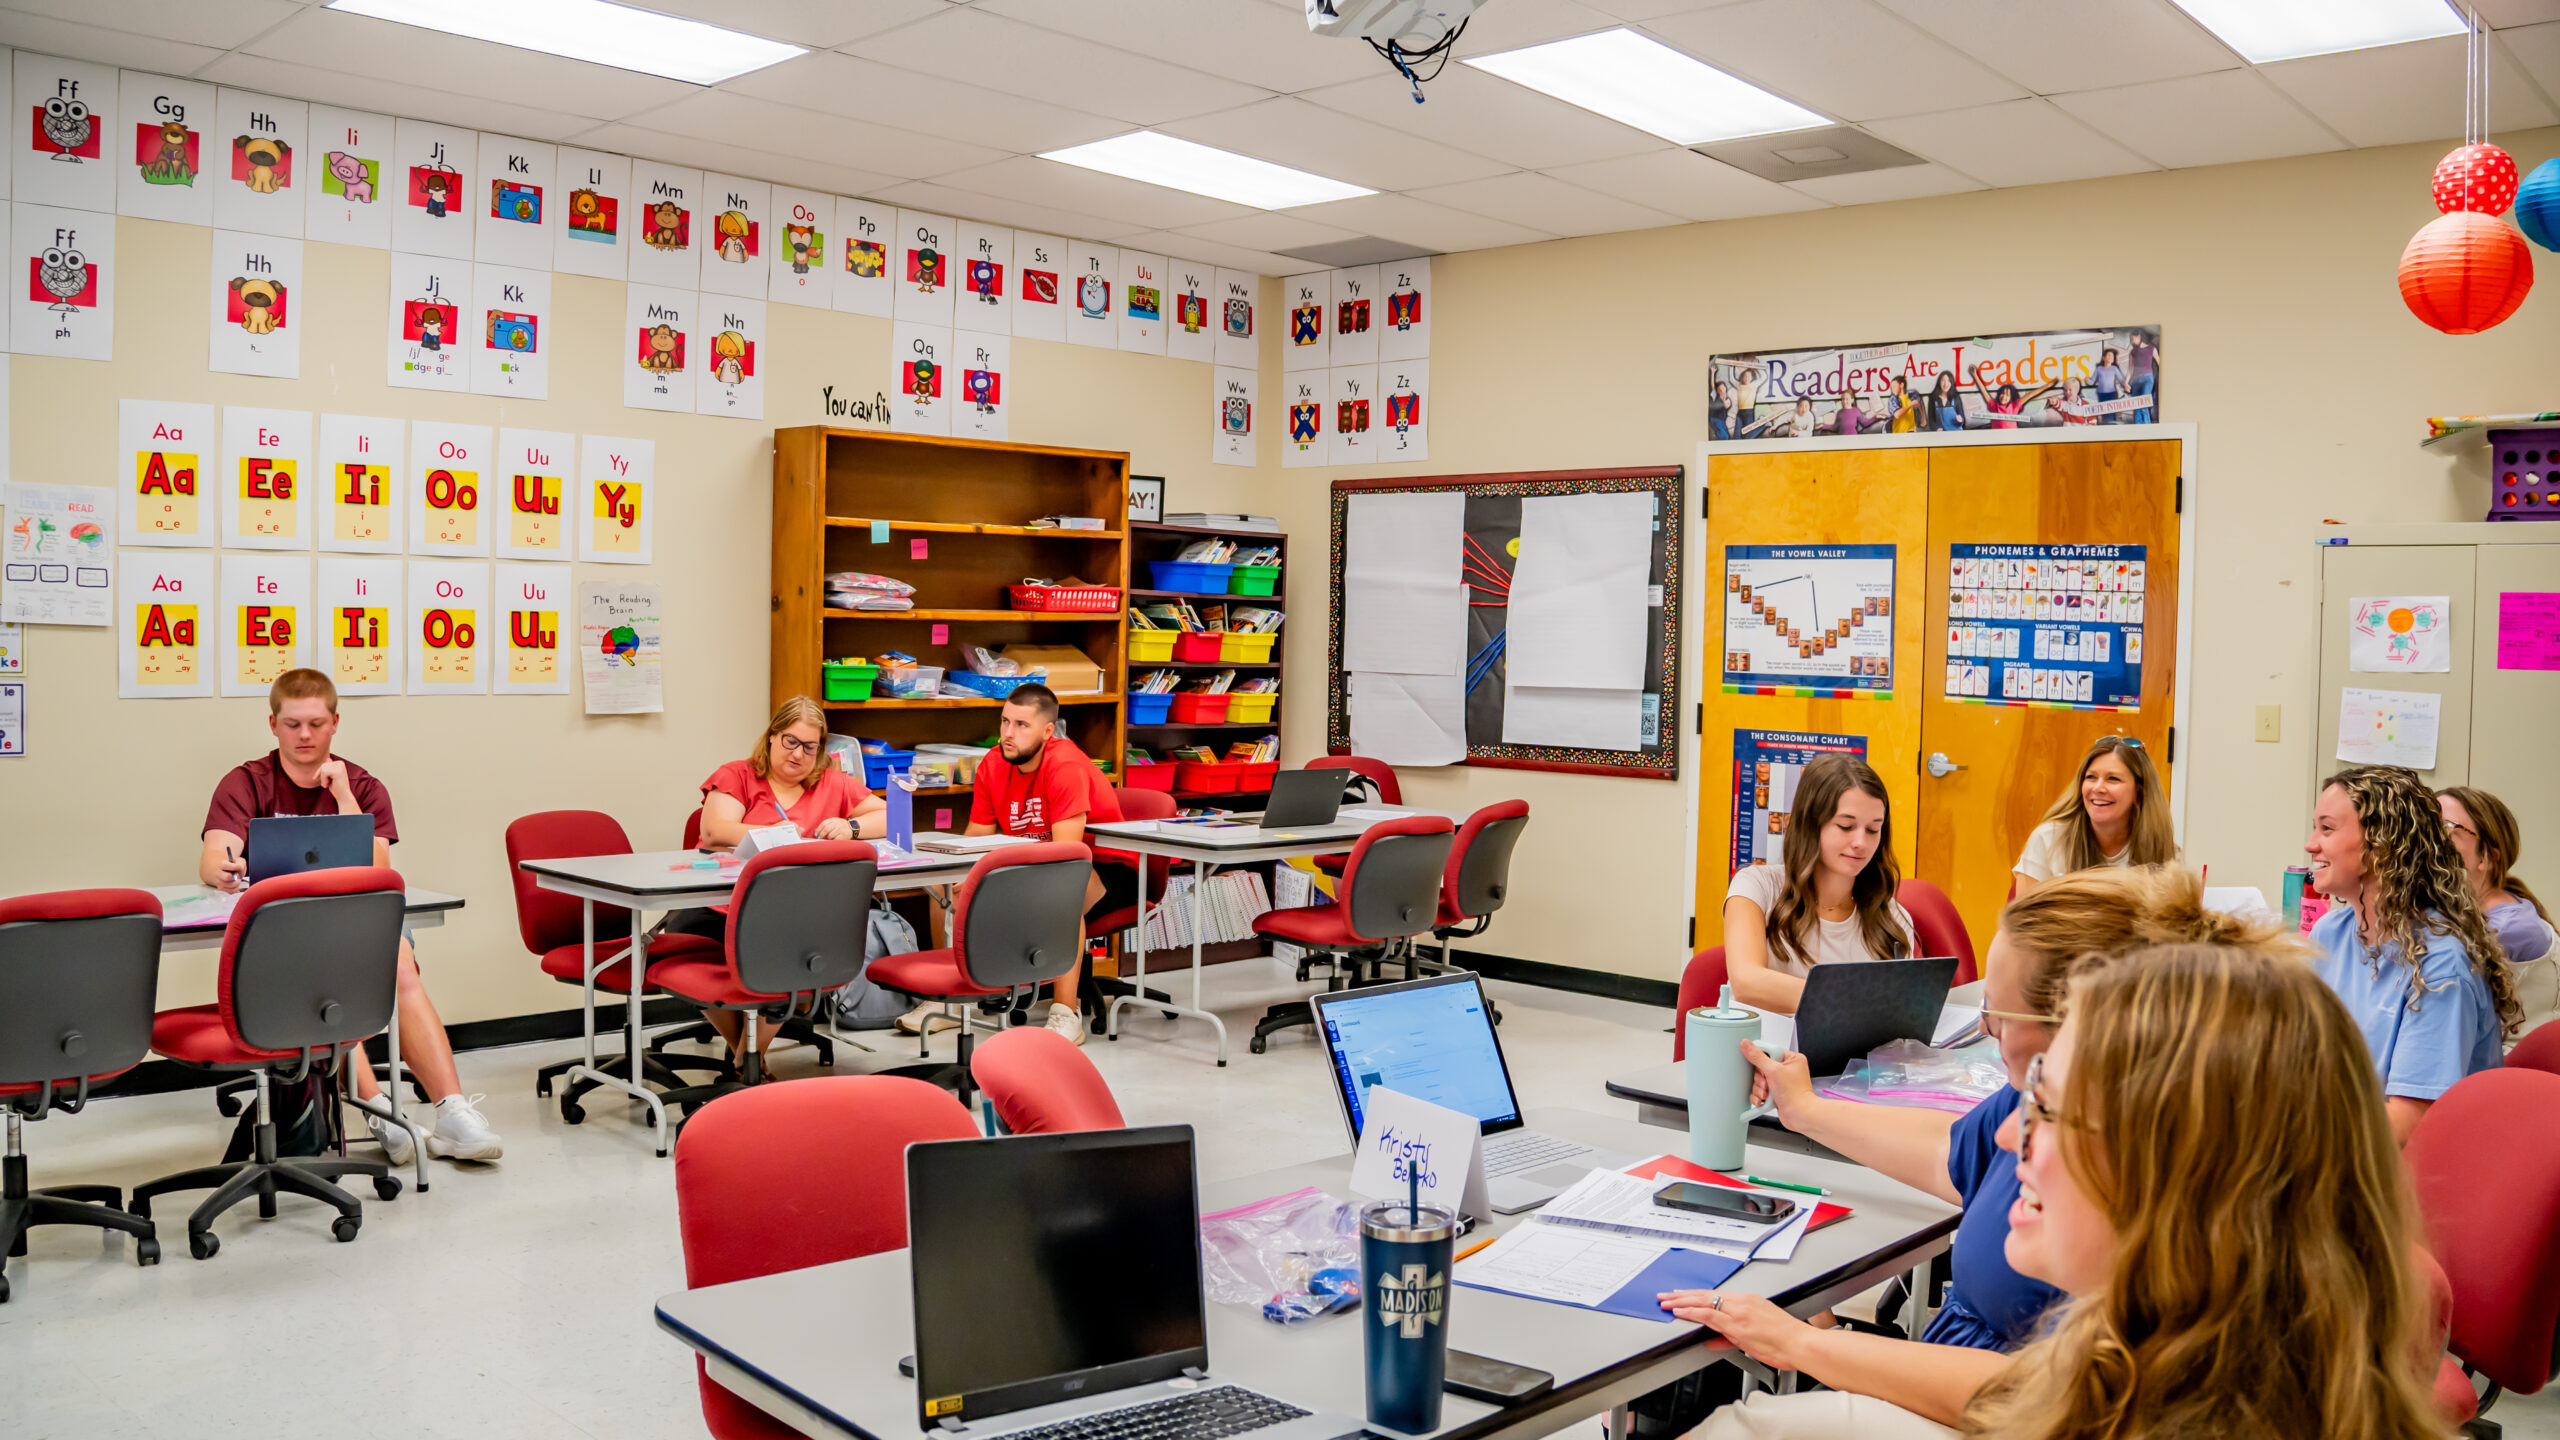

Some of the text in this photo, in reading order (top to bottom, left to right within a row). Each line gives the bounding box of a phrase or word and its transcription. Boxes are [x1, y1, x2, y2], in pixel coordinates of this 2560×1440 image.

[59, 79, 79, 98] Ff
[154, 96, 184, 122] Gg
[251, 112, 276, 132] Hh
[431, 142, 444, 164] Jj
[509, 155, 528, 173] Kk
[653, 181, 682, 199] Mm
[728, 193, 747, 210] Nn
[793, 205, 814, 221] Oo
[859, 216, 875, 235] Pp
[54, 229, 75, 249] Ff
[917, 228, 937, 249] Qq
[980, 238, 992, 253] Rr
[247, 254, 271, 273] Hh
[1036, 248, 1047, 262] Ss
[1089, 257, 1099, 271] Tt
[1138, 265, 1151, 280] Uu
[426, 275, 440, 298] Jj
[1186, 275, 1199, 288] Vv
[1348, 281, 1360, 296] Yy
[1398, 274, 1410, 287] Zz
[504, 285, 523, 302] Kk
[1229, 283, 1247, 297] Ww
[1301, 288, 1312, 300] Xx
[648, 304, 678, 321] Mm
[724, 314, 744, 329] Nn
[56, 327, 70, 339] ph
[913, 339, 933, 359] Qq
[977, 348, 989, 364] Rr
[1765, 352, 1893, 399] Readers
[1903, 353, 1939, 379] Are
[1952, 338, 2091, 388] Leaders
[655, 385, 668, 394] mb
[1228, 381, 1246, 394] Ww
[1347, 380, 1359, 396] Yy
[1397, 375, 1409, 388] Zz
[1299, 385, 1311, 397] Xx
[823, 386, 846, 416] You
[851, 401, 873, 422] can
[153, 422, 182, 440] Aa
[259, 428, 279, 446] Ee
[440, 442, 466, 459] Oo
[528, 448, 548, 465] Uu
[141, 453, 194, 495] Aa
[610, 455, 629, 476] Yy
[248, 458, 292, 499] Ee
[345, 464, 380, 505] Ii
[426, 470, 477, 510] Oo
[514, 475, 558, 514] Uu
[68, 503, 94, 512] READ
[600, 483, 634, 527] Yy
[1975, 546, 2119, 557] PHONEMES & GRAPHEMES
[152, 574, 182, 592] Aa
[257, 576, 277, 593] Ee
[436, 581, 463, 598] Oo
[524, 584, 545, 600] Uu
[593, 594, 650, 607] The Reading
[609, 606, 633, 614] Brain
[140, 604, 195, 647] Aa
[246, 605, 292, 647] Ee
[342, 607, 378, 648] Ii
[423, 609, 475, 648] Oo
[511, 611, 556, 648] Uu
[1750, 732, 1848, 745] THE CONSONANT CHART
[1379, 1124, 1432, 1177] Kristy
[1380, 1286, 1443, 1313] MADISON
